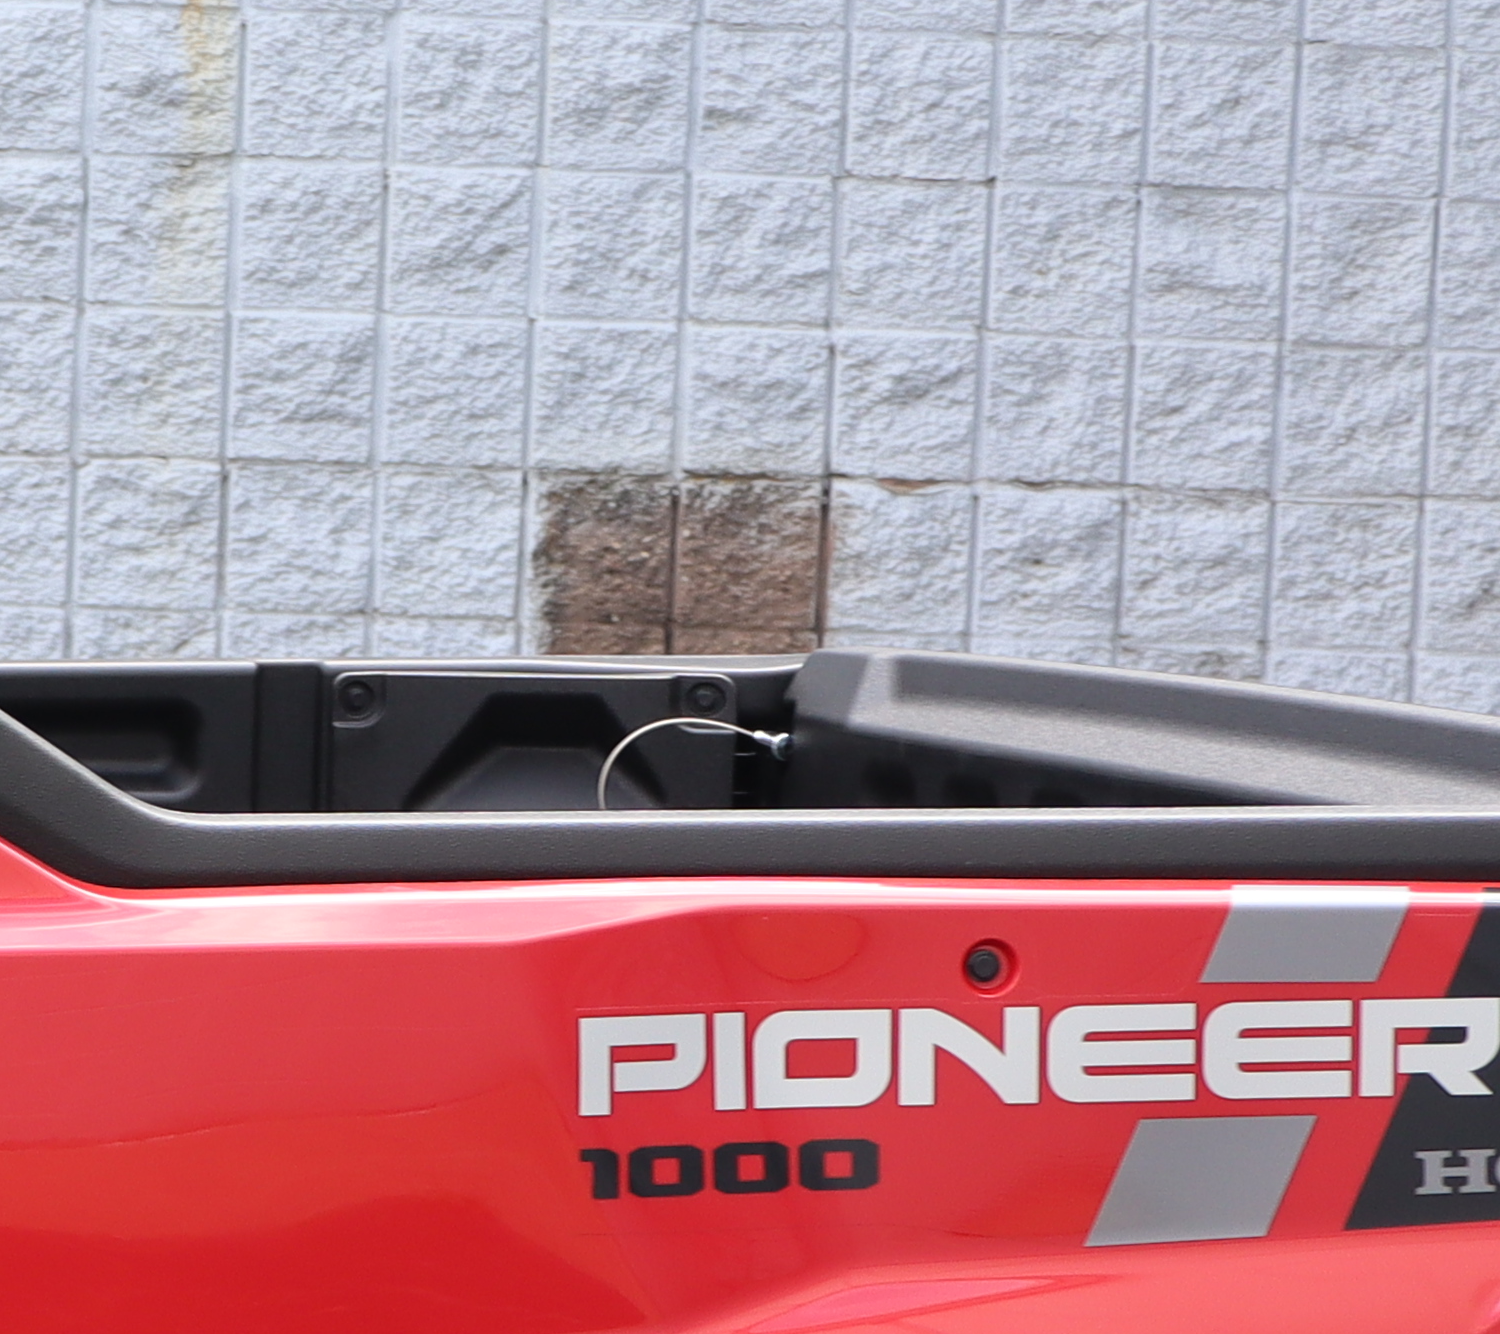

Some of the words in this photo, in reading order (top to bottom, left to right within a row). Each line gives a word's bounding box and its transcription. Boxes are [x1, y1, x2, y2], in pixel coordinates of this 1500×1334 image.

[577, 997, 1500, 1117] PIONEER
[579, 1137, 881, 1200] 1000
[1413, 1148, 1500, 1195] H
